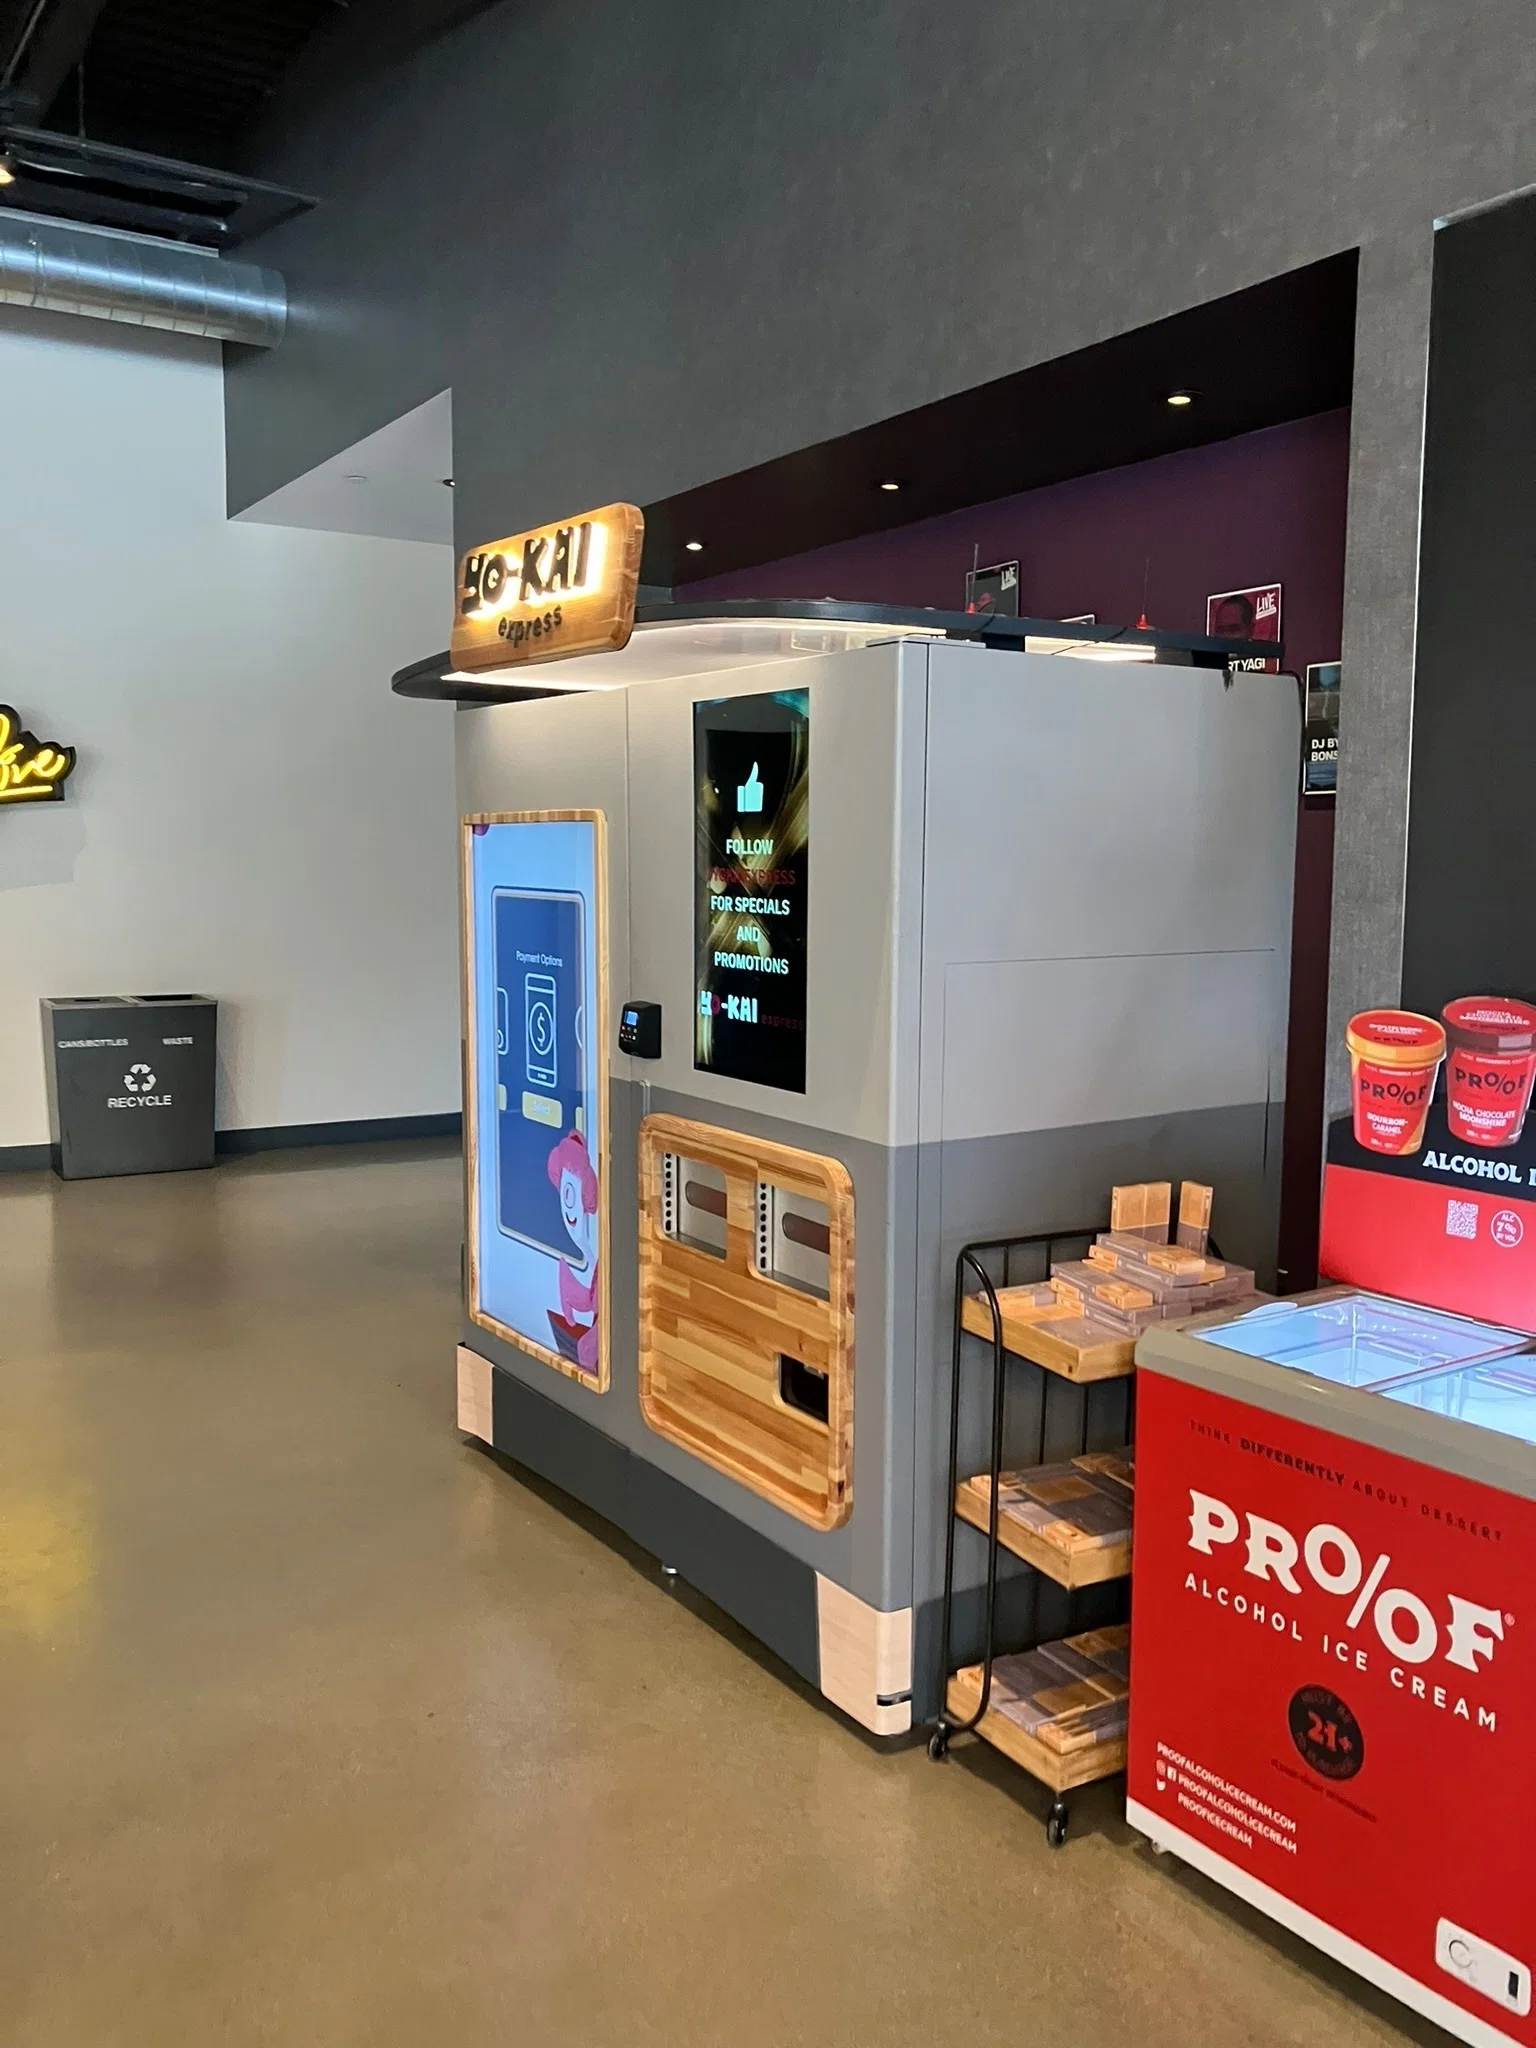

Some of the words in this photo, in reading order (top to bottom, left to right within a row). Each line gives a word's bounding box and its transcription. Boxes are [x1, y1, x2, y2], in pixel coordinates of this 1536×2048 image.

[461, 522, 592, 614] YO-KAI
[1256, 592, 1276, 615] LIVE
[498, 604, 562, 648] express
[1241, 658, 1265, 671] YAGI
[1311, 738, 1325, 749] DJ
[726, 839, 774, 855] FOLLOW
[710, 895, 732, 912] FOR
[734, 897, 790, 915] SPECIALS
[736, 925, 760, 942] AND
[516, 950, 539, 964] Payment
[541, 953, 562, 967] Options
[714, 951, 789, 975] PROMOTIONS
[162, 1036, 193, 1045] WASTE
[107, 1094, 172, 1109] RECYCLE
[1475, 1107, 1516, 1119] CHOCOLATE
[1371, 1121, 1402, 1135] CARAMEL
[1422, 1150, 1522, 1183] ALCOHOL
[1496, 1221, 1517, 1235] 7%
[1501, 1213, 1515, 1223] ALC
[1240, 1436, 1345, 1487] DIFFERENTLY
[1352, 1480, 1408, 1508] ABOUT
[1421, 1503, 1502, 1540] DESSERT
[1185, 1572, 1303, 1642] ALCOHOL
[1323, 1634, 1368, 1671] ICE
[1390, 1666, 1497, 1732] CREAM
[1307, 1710, 1353, 1753] 21+
[1157, 1740, 1297, 1834] PROOFALCOHOLICECREAM.COM
[1178, 1772, 1297, 1855] PROOFALCOHOLICECREAM
[1178, 1791, 1253, 1848] PROOFICECREAM
